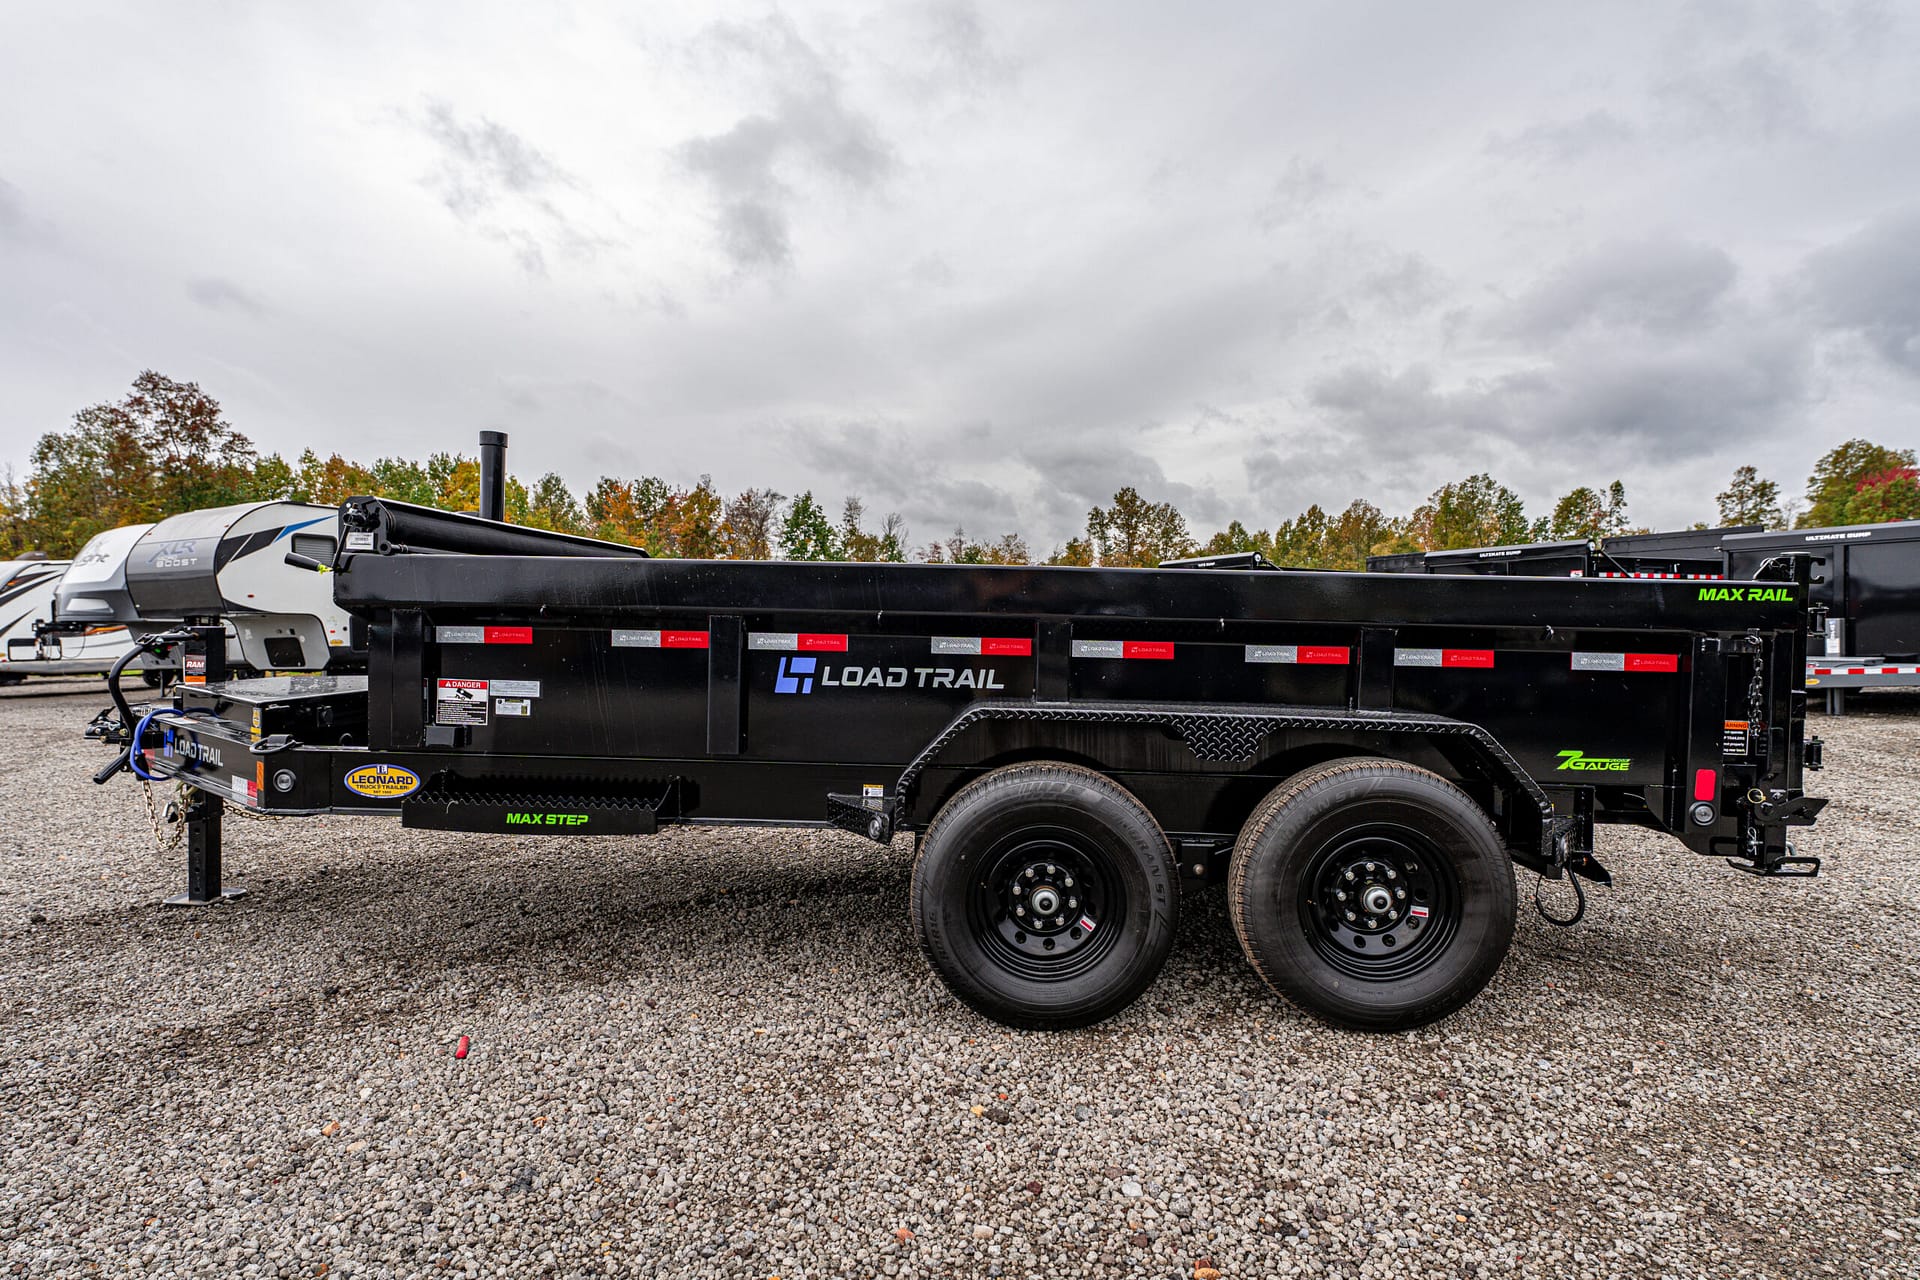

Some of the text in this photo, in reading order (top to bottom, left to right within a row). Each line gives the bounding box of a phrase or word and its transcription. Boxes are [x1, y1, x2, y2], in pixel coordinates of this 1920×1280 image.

[1805, 531, 1872, 541] ULTIMATE DUMP
[156, 558, 198, 568] BOOST
[1698, 588, 1793, 602] MAX RAIL
[186, 660, 205, 668] RAM
[822, 666, 1005, 689] LOAD TRAIL
[452, 681, 481, 689] DANGER
[174, 737, 224, 767] LOAD TRAIL
[1568, 758, 1631, 771] GAUGE
[352, 775, 414, 785] LEONARD
[506, 813, 589, 826] MAX STEP
